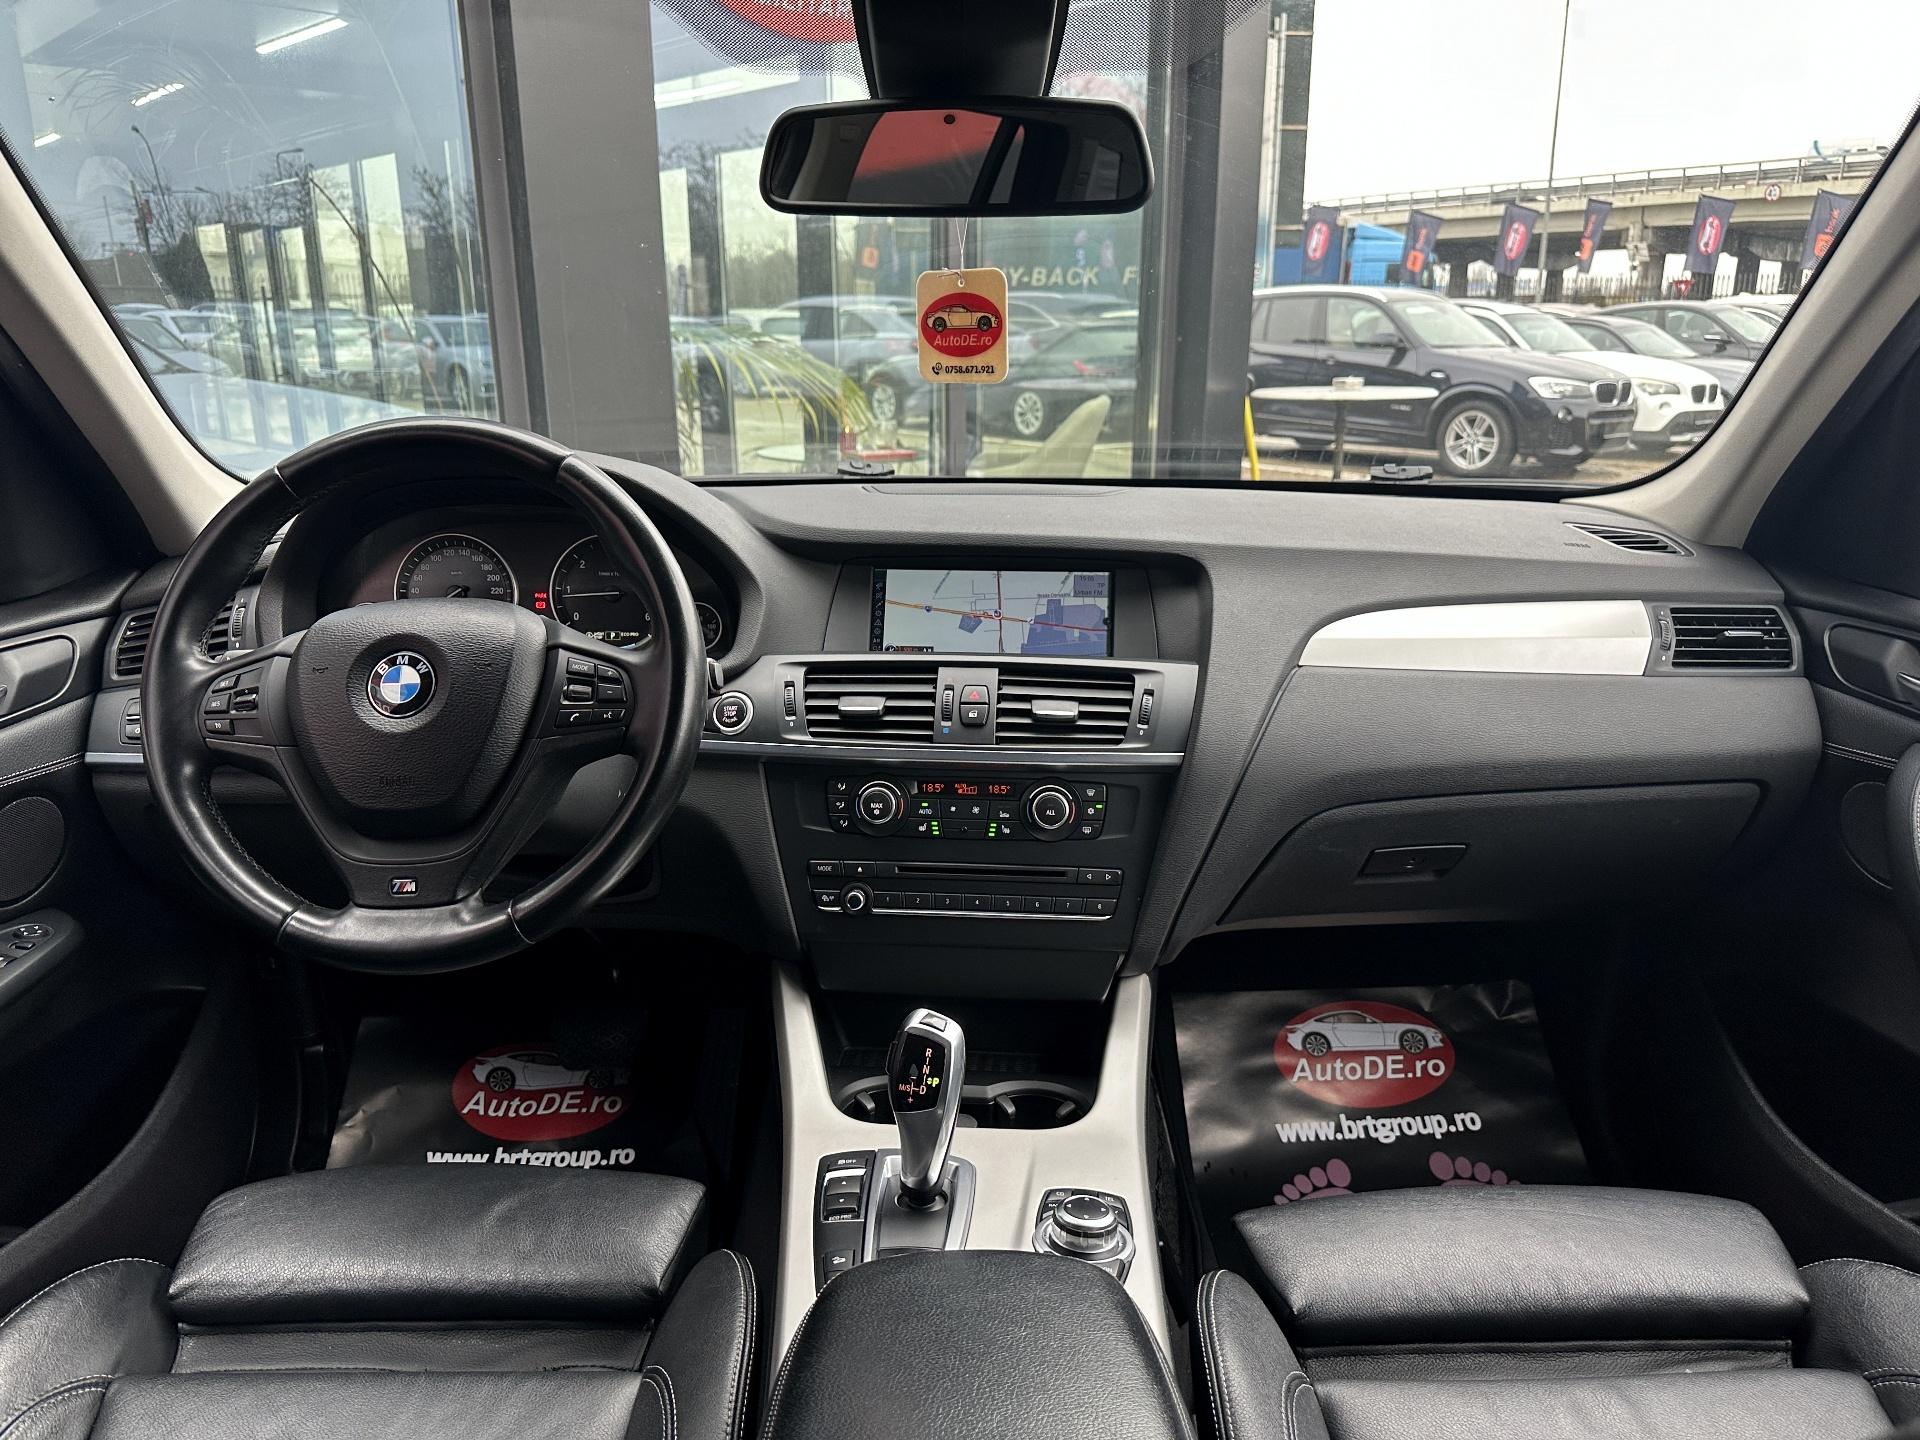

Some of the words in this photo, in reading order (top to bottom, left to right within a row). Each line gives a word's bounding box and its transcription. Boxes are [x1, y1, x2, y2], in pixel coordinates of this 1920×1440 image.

[1003, 265, 1099, 287] Y-BACK
[934, 333, 992, 346] AutoDE.ro
[945, 365, 995, 374] 0758.671.921
[579, 561, 586, 569] 2
[566, 585, 570, 593] 1
[573, 612, 579, 620] 0
[645, 613, 651, 621] 6
[377, 656, 429, 675] BMW
[925, 1048, 932, 1057] R
[922, 1065, 930, 1074] N
[1293, 1054, 1446, 1082] AutoDE.ro
[920, 1085, 927, 1094] D
[462, 1089, 623, 1118] AutoDE.ro
[1274, 1109, 1482, 1144] www.brtgroup.ro
